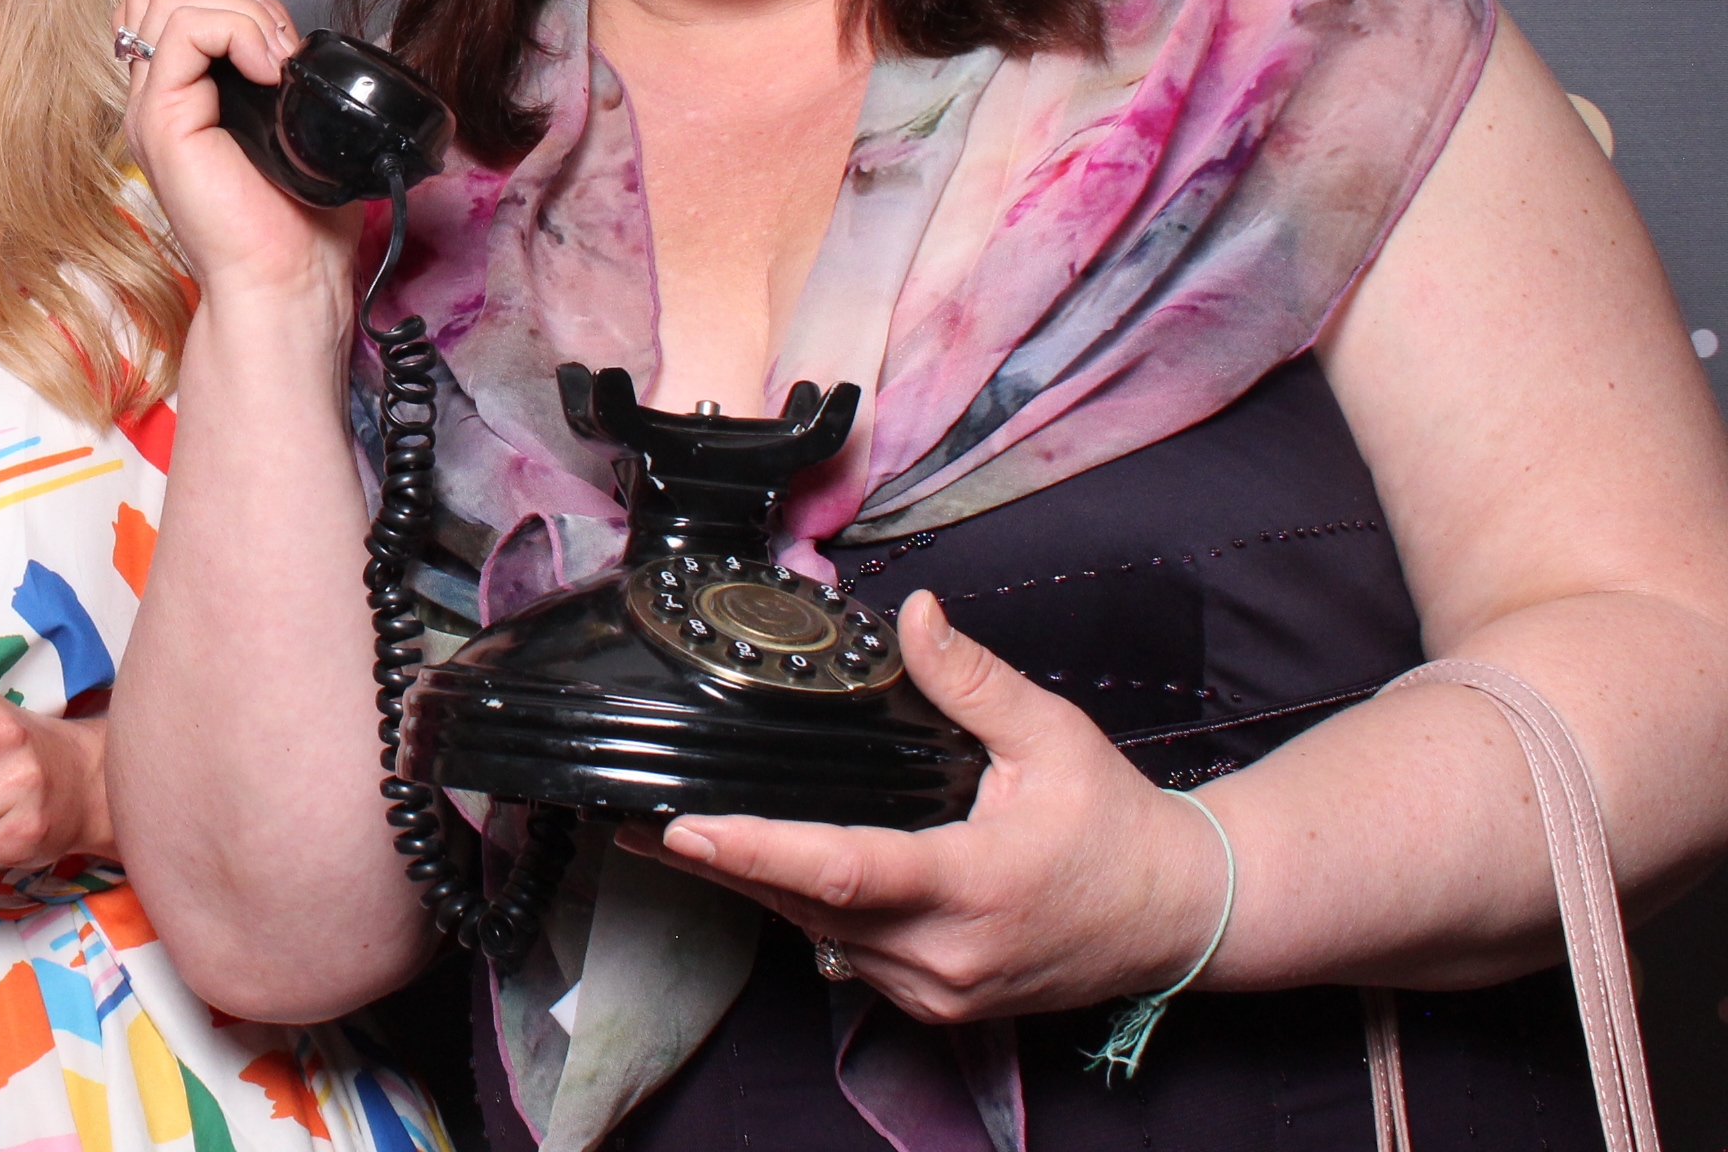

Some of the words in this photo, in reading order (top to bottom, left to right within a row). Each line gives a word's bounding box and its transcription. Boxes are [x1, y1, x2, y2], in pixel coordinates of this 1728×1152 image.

[821, 584, 837, 596] 2
[856, 611, 870, 623] 1
[688, 619, 706, 632] 8
[735, 641, 751, 654] 9
